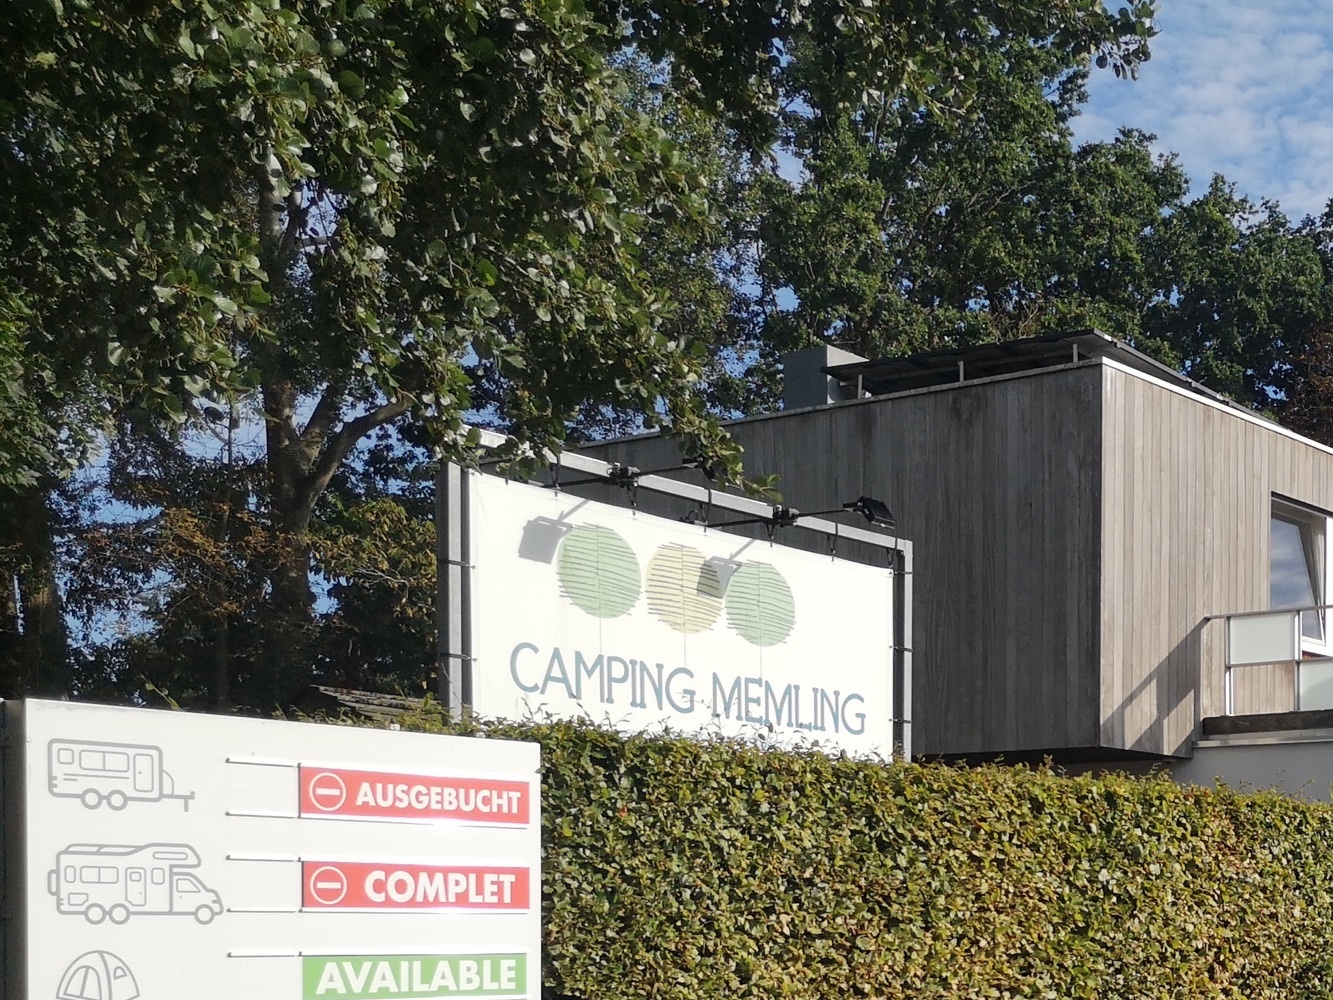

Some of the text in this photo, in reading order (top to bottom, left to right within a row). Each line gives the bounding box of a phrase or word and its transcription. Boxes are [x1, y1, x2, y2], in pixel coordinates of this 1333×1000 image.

[510, 642, 866, 735] CAMPING MEMLING
[356, 781, 521, 814] AUSGEBUCHT
[365, 871, 516, 904] COMPLET
[316, 959, 517, 995] AVAILABLE
